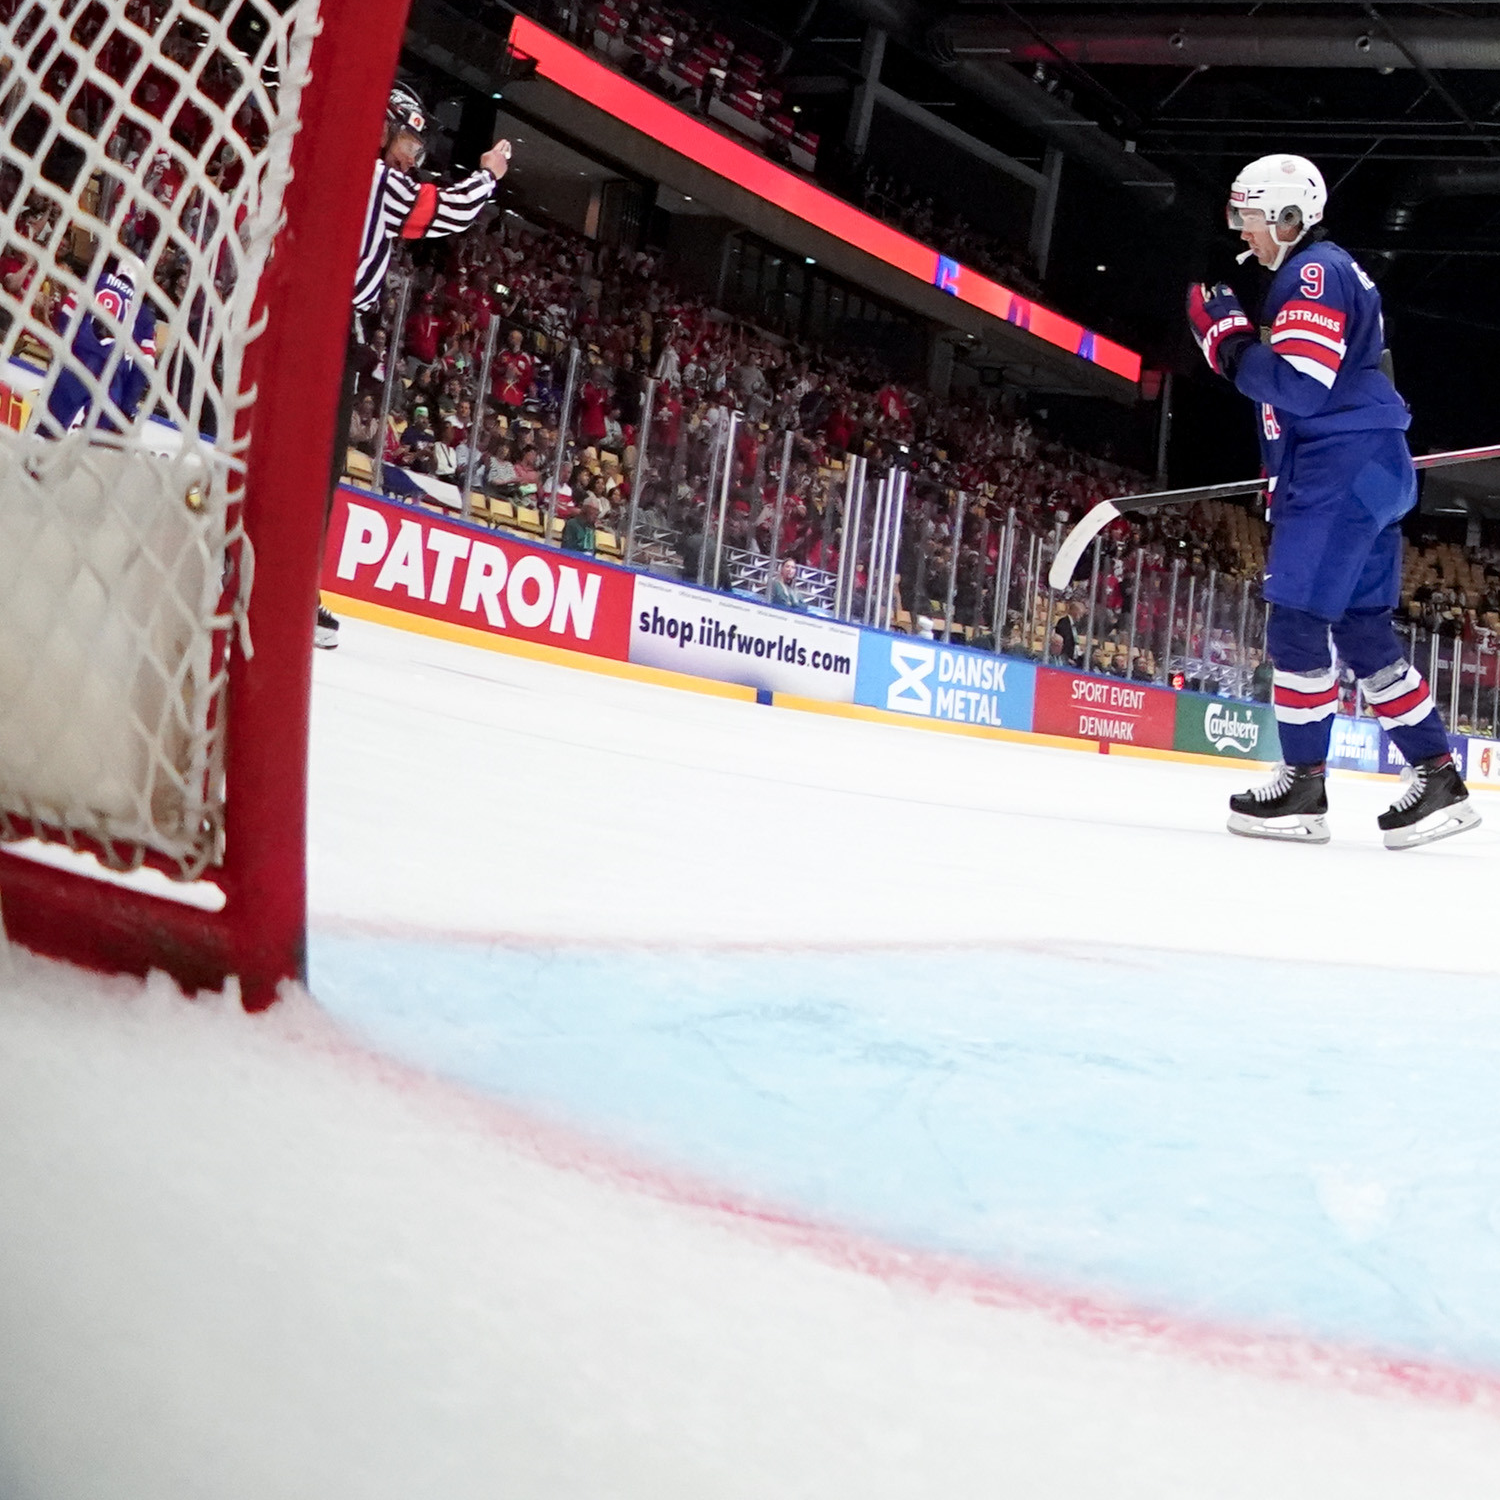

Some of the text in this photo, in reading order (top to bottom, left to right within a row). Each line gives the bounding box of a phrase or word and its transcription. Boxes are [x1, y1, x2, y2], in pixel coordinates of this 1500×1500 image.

[1300, 263, 1325, 299] 9
[1288, 310, 1340, 332] STRAUSS
[337, 503, 602, 641] PATRON
[639, 606, 851, 675] shop.iihfworlds.com
[938, 652, 1007, 692] DANSK
[937, 692, 1002, 726] METAL
[1072, 679, 1145, 710] SPORT EVENT
[1079, 715, 1134, 741] DENMARK
[1204, 702, 1259, 750] Carlsberg
